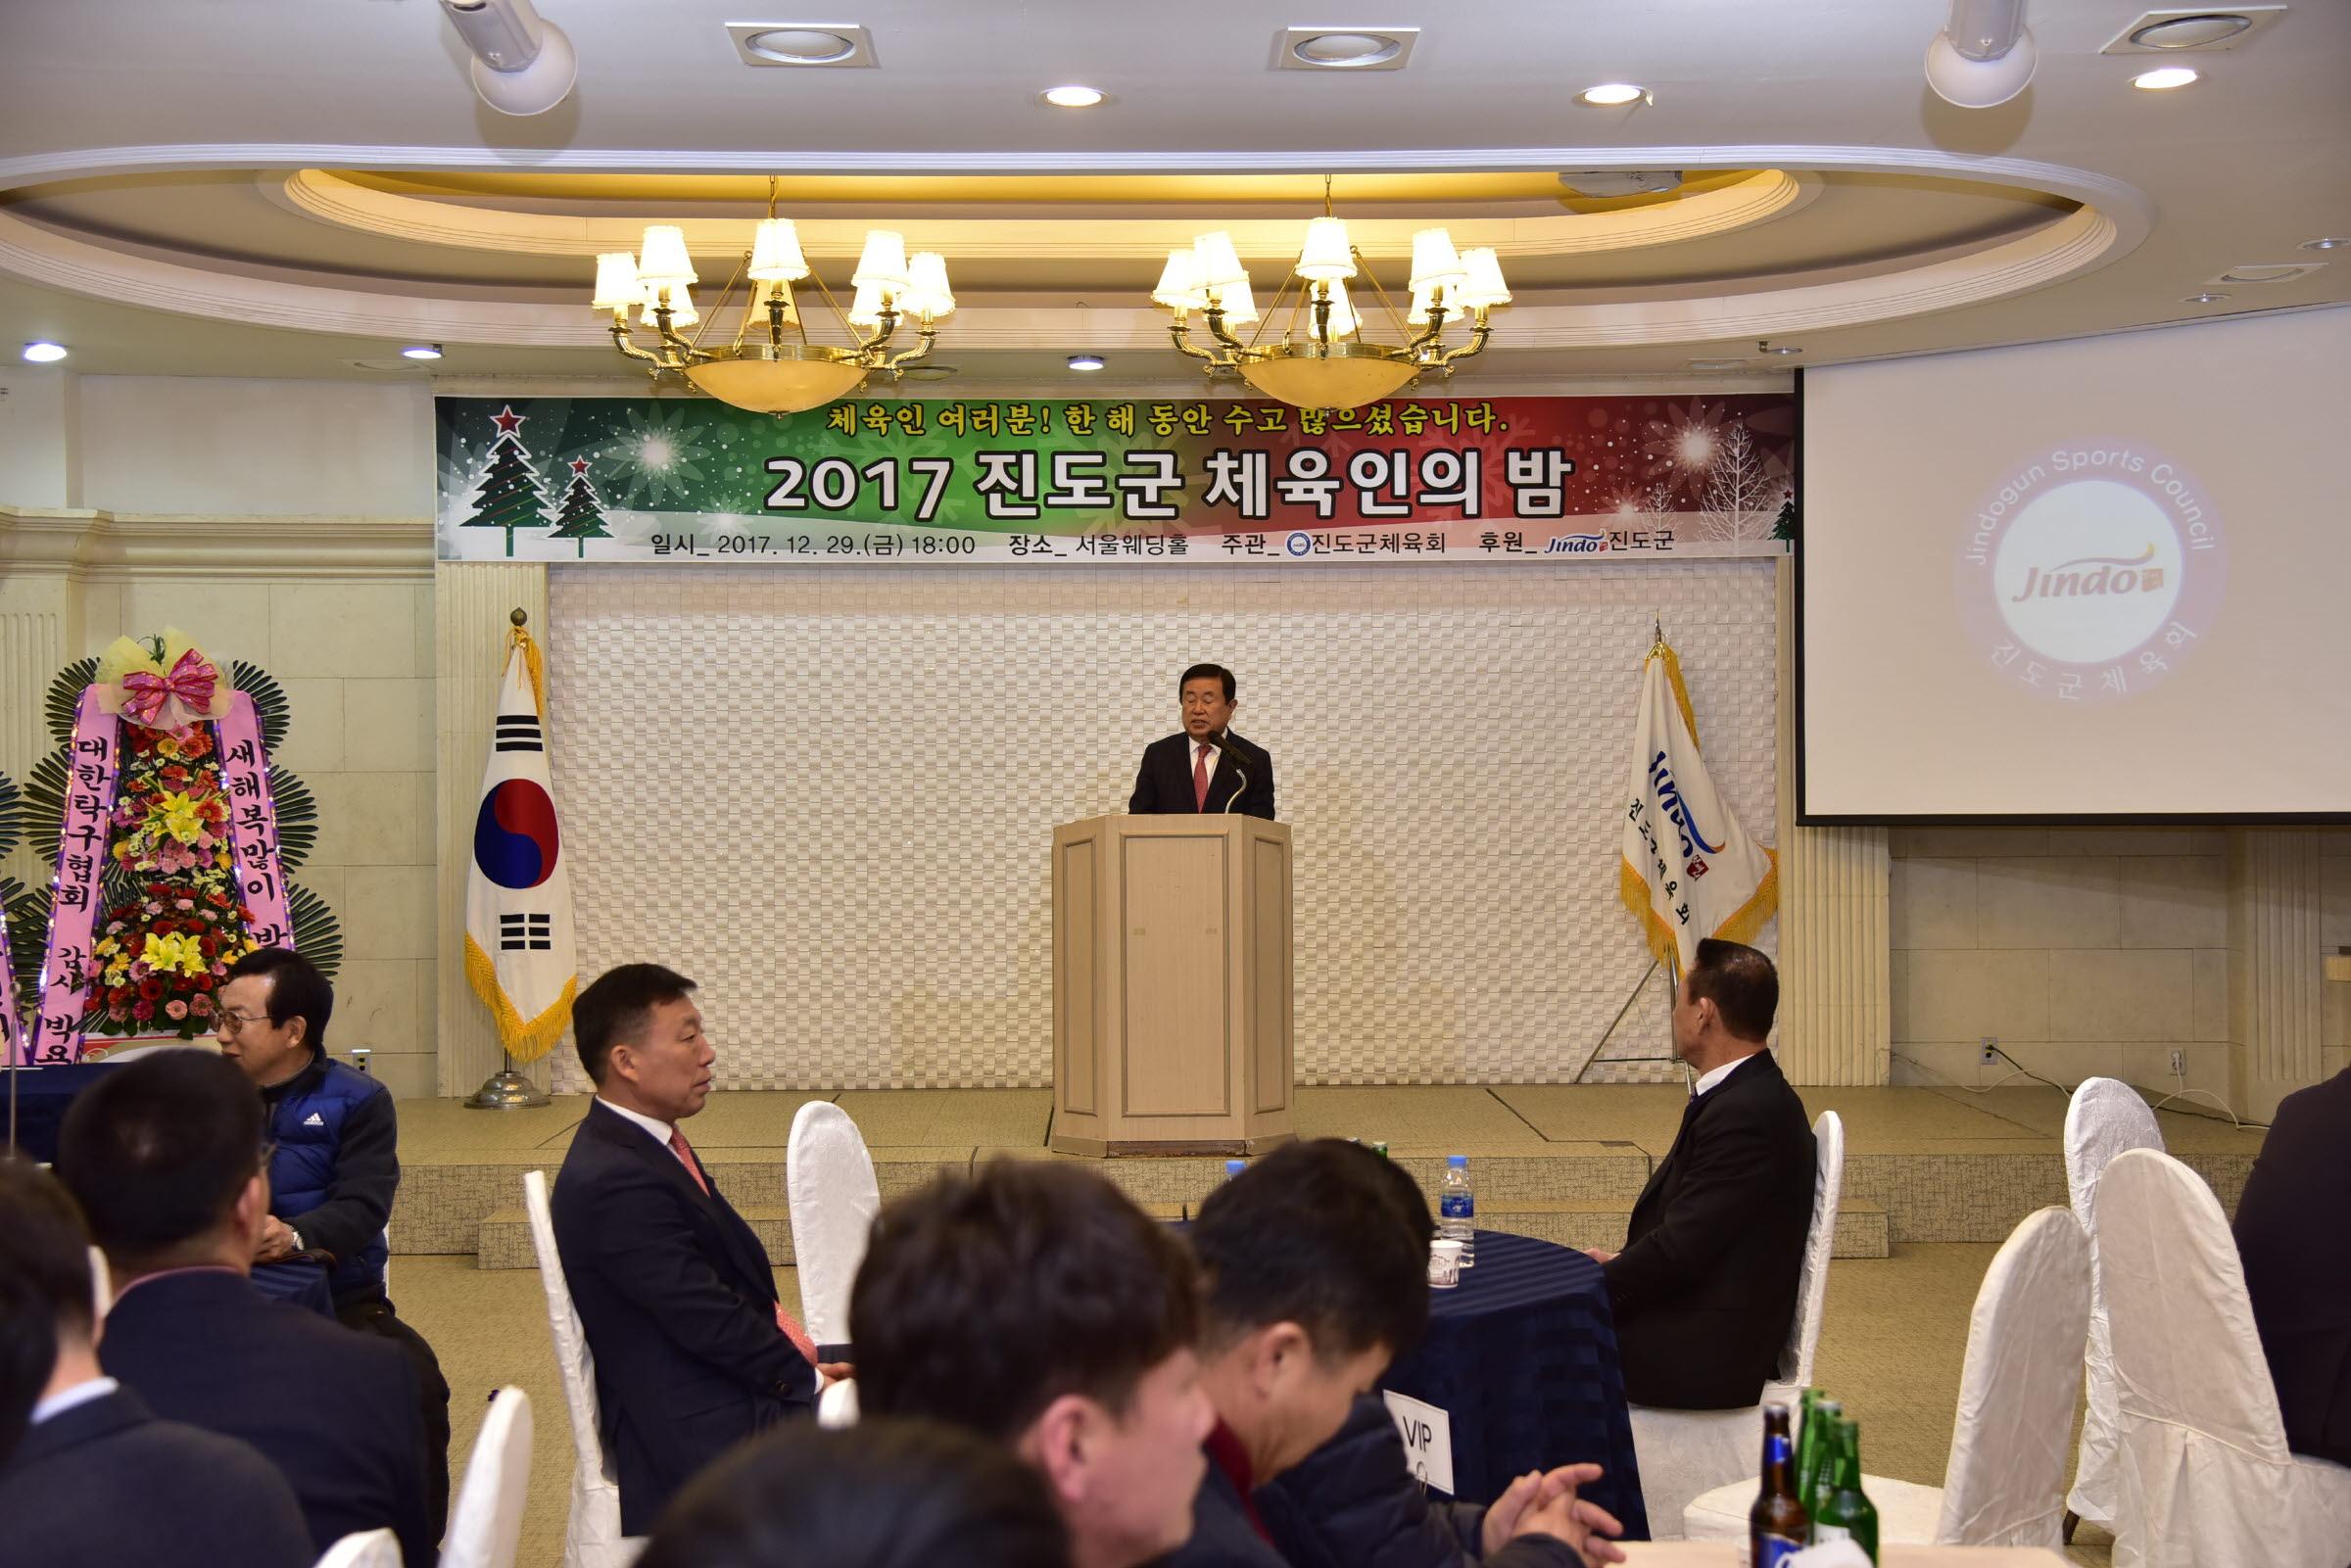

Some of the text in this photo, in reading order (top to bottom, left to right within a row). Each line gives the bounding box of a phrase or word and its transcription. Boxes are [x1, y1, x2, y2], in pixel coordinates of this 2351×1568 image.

[826, 403, 1509, 437] 체육인 여러분! 한 해 동안 수고 많으셨습니다.
[764, 447, 1575, 521] 2017 진도군 체육인의 밤
[1965, 449, 2215, 566] Jindogun Sports Council
[717, 536, 777, 555] 2017.
[787, 536, 817, 555] 12.
[912, 536, 976, 554] 18:00
[1076, 534, 1189, 555] 서울웨딩홀
[1312, 533, 1446, 554] 진도군체육회
[1544, 537, 1598, 554] Jindo
[1609, 530, 1675, 550] 진도군
[2011, 565, 2138, 603] Jindo
[1991, 621, 2198, 701] 진도군체육회
[58, 736, 111, 913] 대한탁구협회
[225, 739, 275, 902] 새해복많이
[1403, 1415, 1432, 1452] VIP
